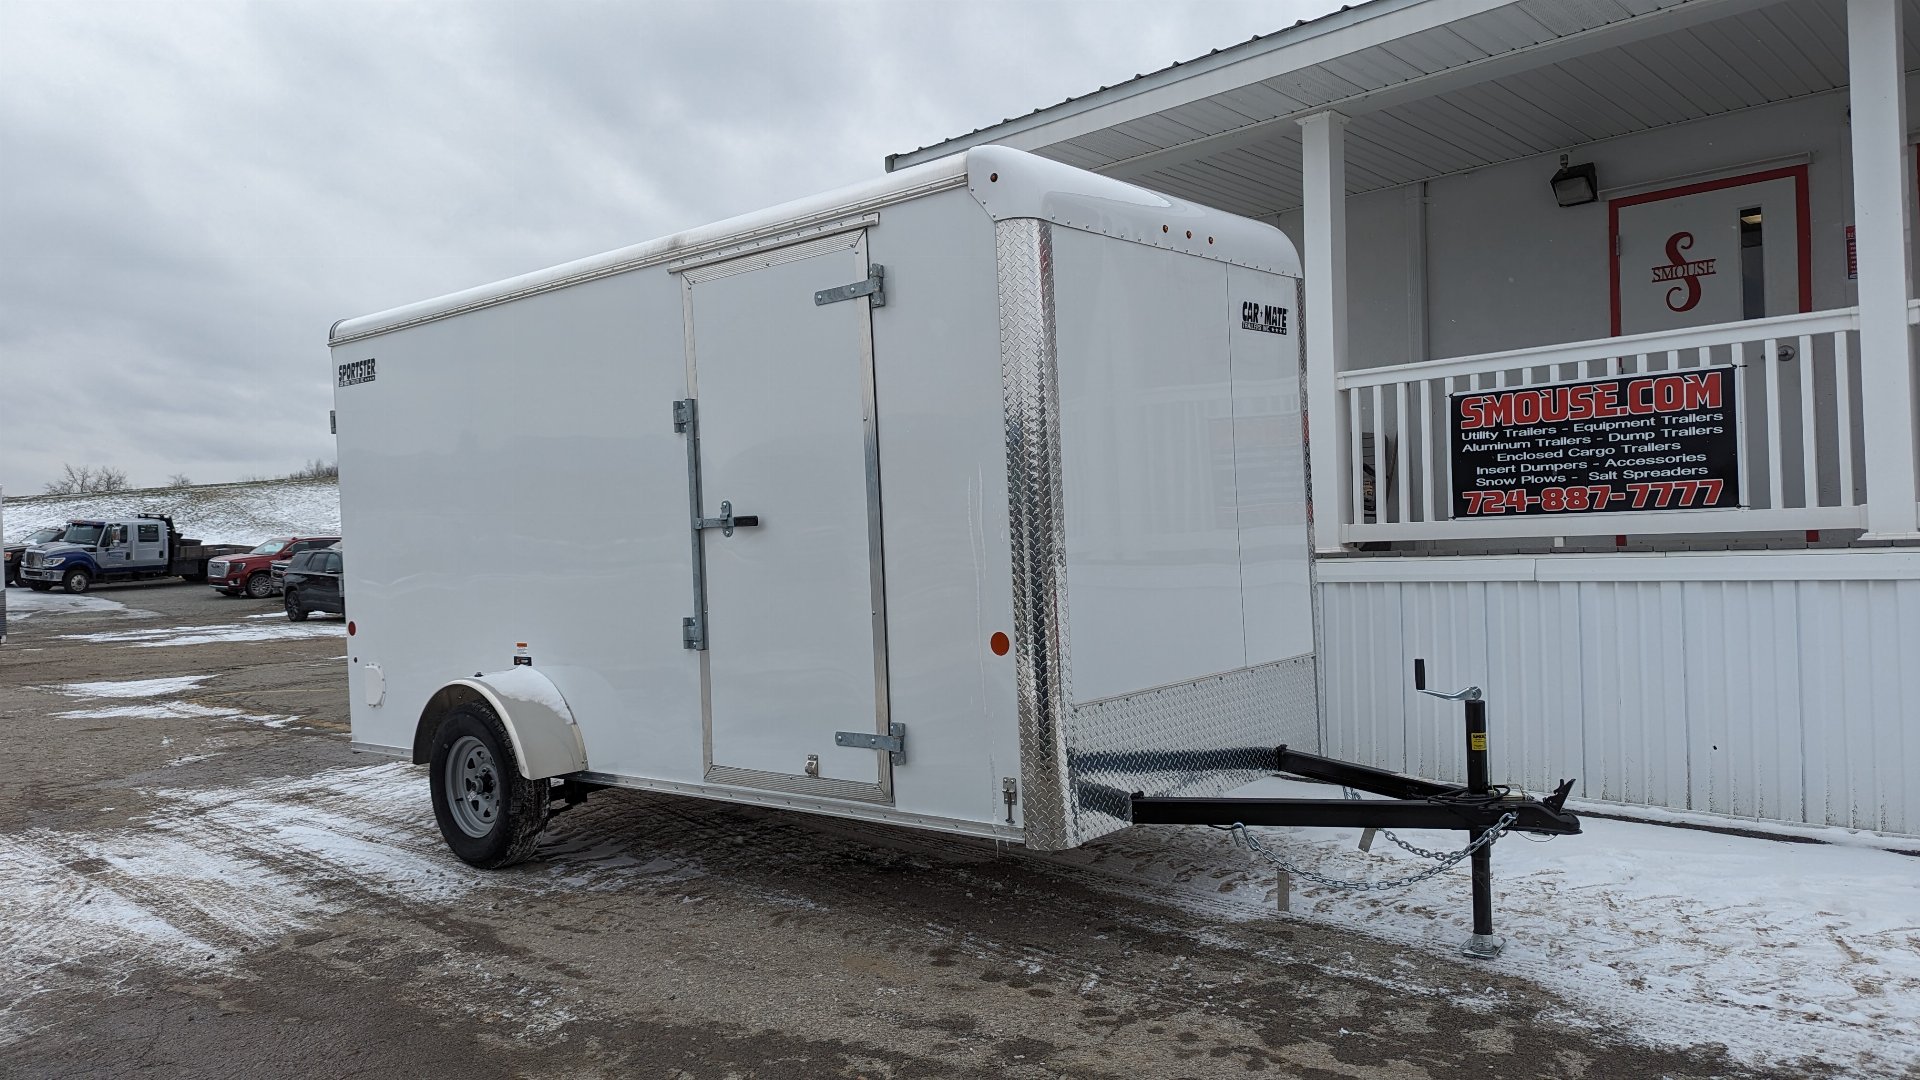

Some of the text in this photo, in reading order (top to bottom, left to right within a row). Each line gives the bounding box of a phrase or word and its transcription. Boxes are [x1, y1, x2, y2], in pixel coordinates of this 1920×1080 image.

[1652, 259, 1716, 283] SMOUSE
[1242, 301, 1287, 327] CAR MATE
[338, 358, 376, 382] SPORTSTER
[1460, 372, 1722, 430] SMOUSE.COM
[1462, 431, 1499, 441] Utility
[1503, 427, 1557, 438] Trailers
[1574, 417, 1656, 433] Equipment
[1661, 414, 1724, 425] Trailers
[1462, 442, 1531, 453] Aluminum
[1536, 437, 1592, 447] Trailers
[1609, 432, 1656, 442] Dump
[1661, 427, 1724, 438] Trailers
[1477, 465, 1516, 475] Insert
[1521, 462, 1588, 473] Dumpers
[1605, 454, 1707, 468] Accessories
[1498, 443, 1682, 462] Enclosed Cargo Trailers
[1476, 478, 1517, 487] Snow
[1522, 476, 1567, 485] Plows
[1589, 471, 1618, 481] Salt
[1623, 467, 1709, 481] Spreaders
[1462, 478, 1724, 515] 724-887-7777
